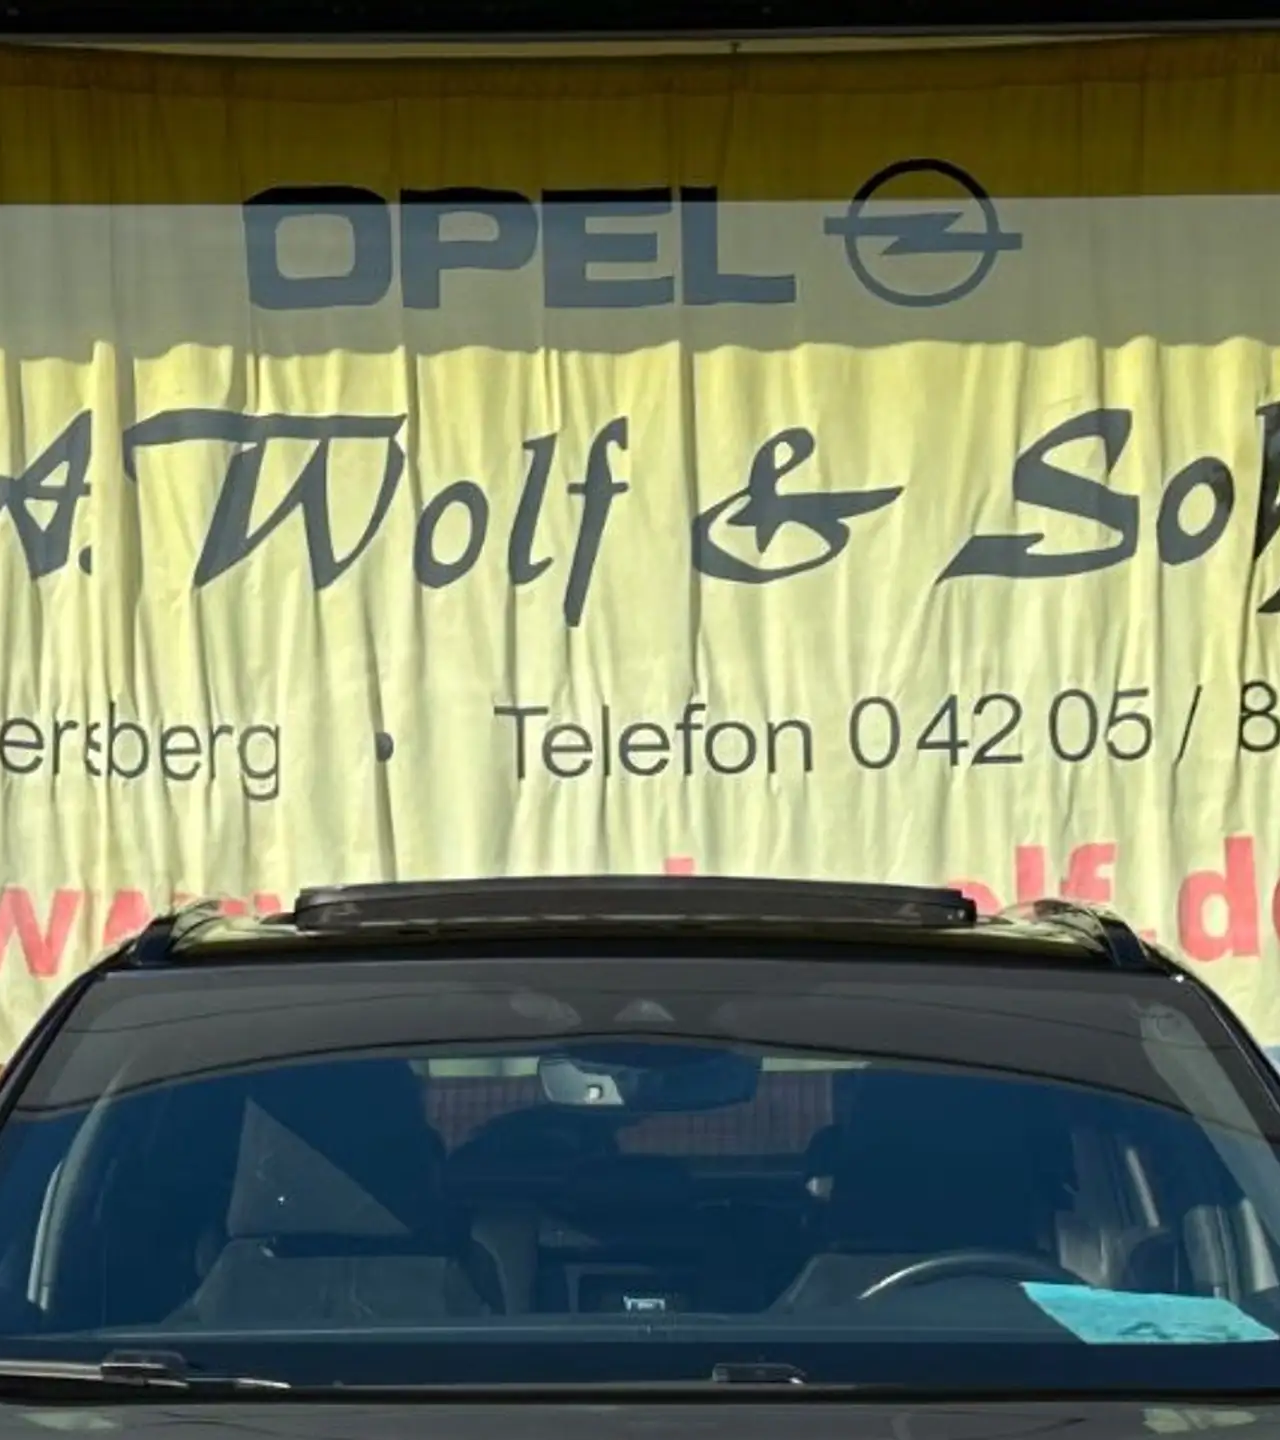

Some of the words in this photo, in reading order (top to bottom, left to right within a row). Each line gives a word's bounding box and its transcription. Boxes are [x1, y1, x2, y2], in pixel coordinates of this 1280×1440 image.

[242, 185, 796, 310] OPEL
[122, 407, 628, 628] Wolf
[691, 426, 905, 585] &
[494, 703, 814, 781] Telefon
